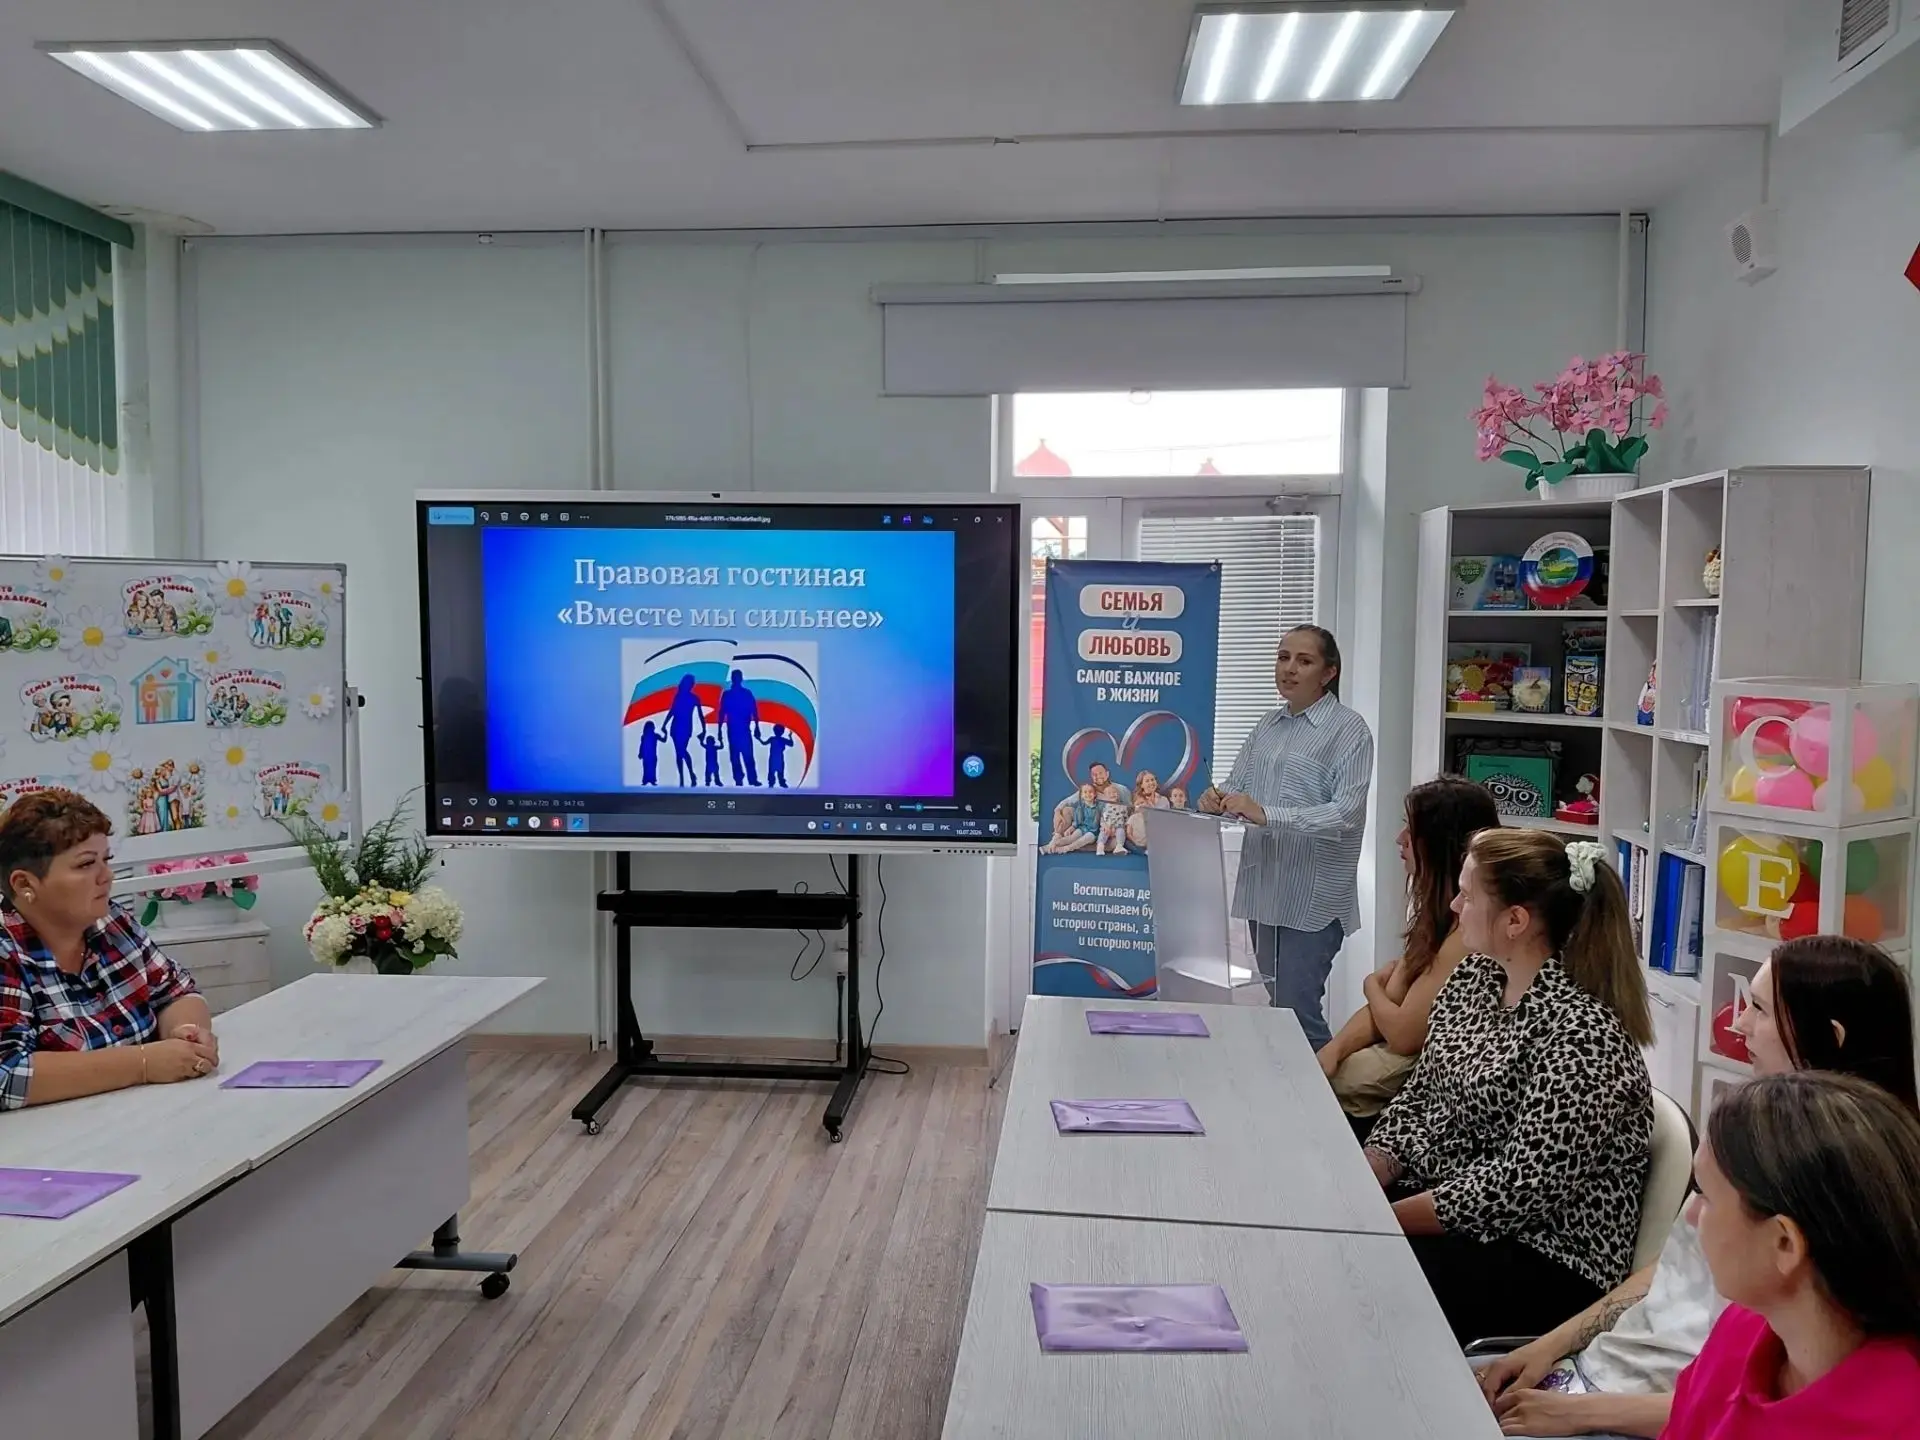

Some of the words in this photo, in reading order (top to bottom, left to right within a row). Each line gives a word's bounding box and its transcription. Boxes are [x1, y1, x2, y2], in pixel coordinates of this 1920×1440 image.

[574, 559, 720, 591] Правовая
[727, 566, 866, 588] гостиная
[1101, 591, 1163, 611] СЕМЬЯ
[557, 600, 682, 627] «Вместе
[690, 607, 736, 627] мы
[744, 608, 884, 629] сильнее»
[1089, 635, 1171, 657] ЛЮБОВЬ
[1076, 669, 1121, 684] САМОЕ
[1124, 671, 1181, 686] ВАЖНОЕ
[1097, 687, 1106, 701] В
[1110, 688, 1160, 703] ЖИЗНИ
[1073, 882, 1134, 899] Воспитывая
[1052, 901, 1069, 911] мы
[1071, 902, 1139, 916] воспитываем
[1053, 918, 1096, 932] историю
[1098, 921, 1138, 934] страны,
[1142, 924, 1150, 934] а
[1078, 936, 1085, 946] и
[1087, 937, 1130, 951] историю
